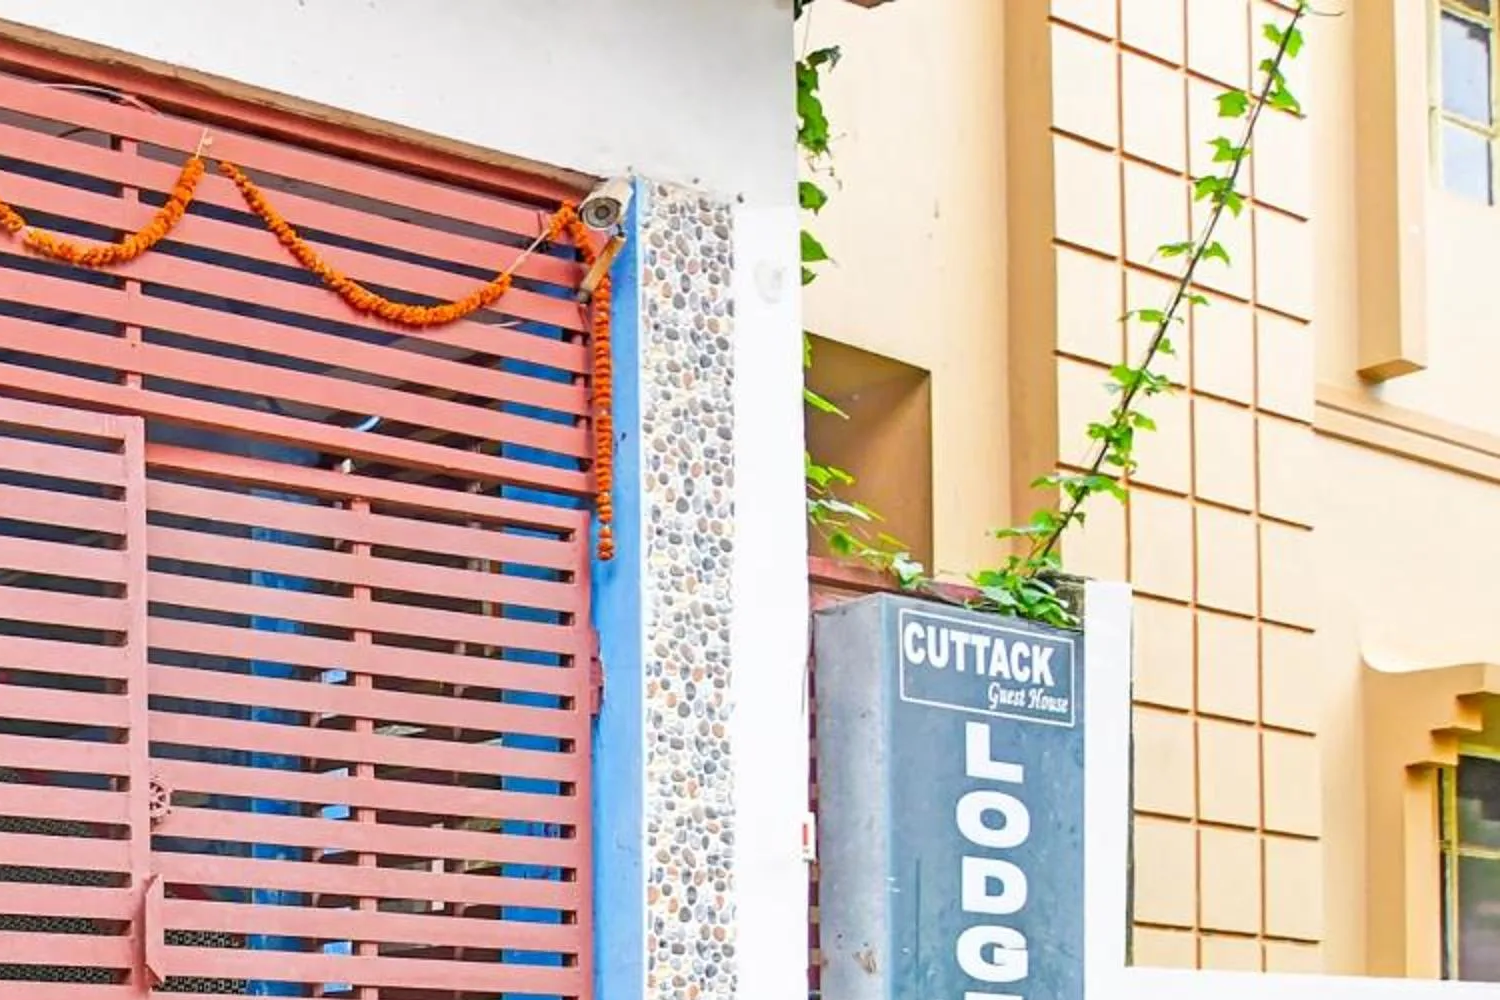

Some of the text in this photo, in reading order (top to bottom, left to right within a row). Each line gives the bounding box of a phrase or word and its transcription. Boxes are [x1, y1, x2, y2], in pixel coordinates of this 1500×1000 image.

[904, 621, 1055, 687] CUTTACK
[988, 681, 1069, 713] Guest House
